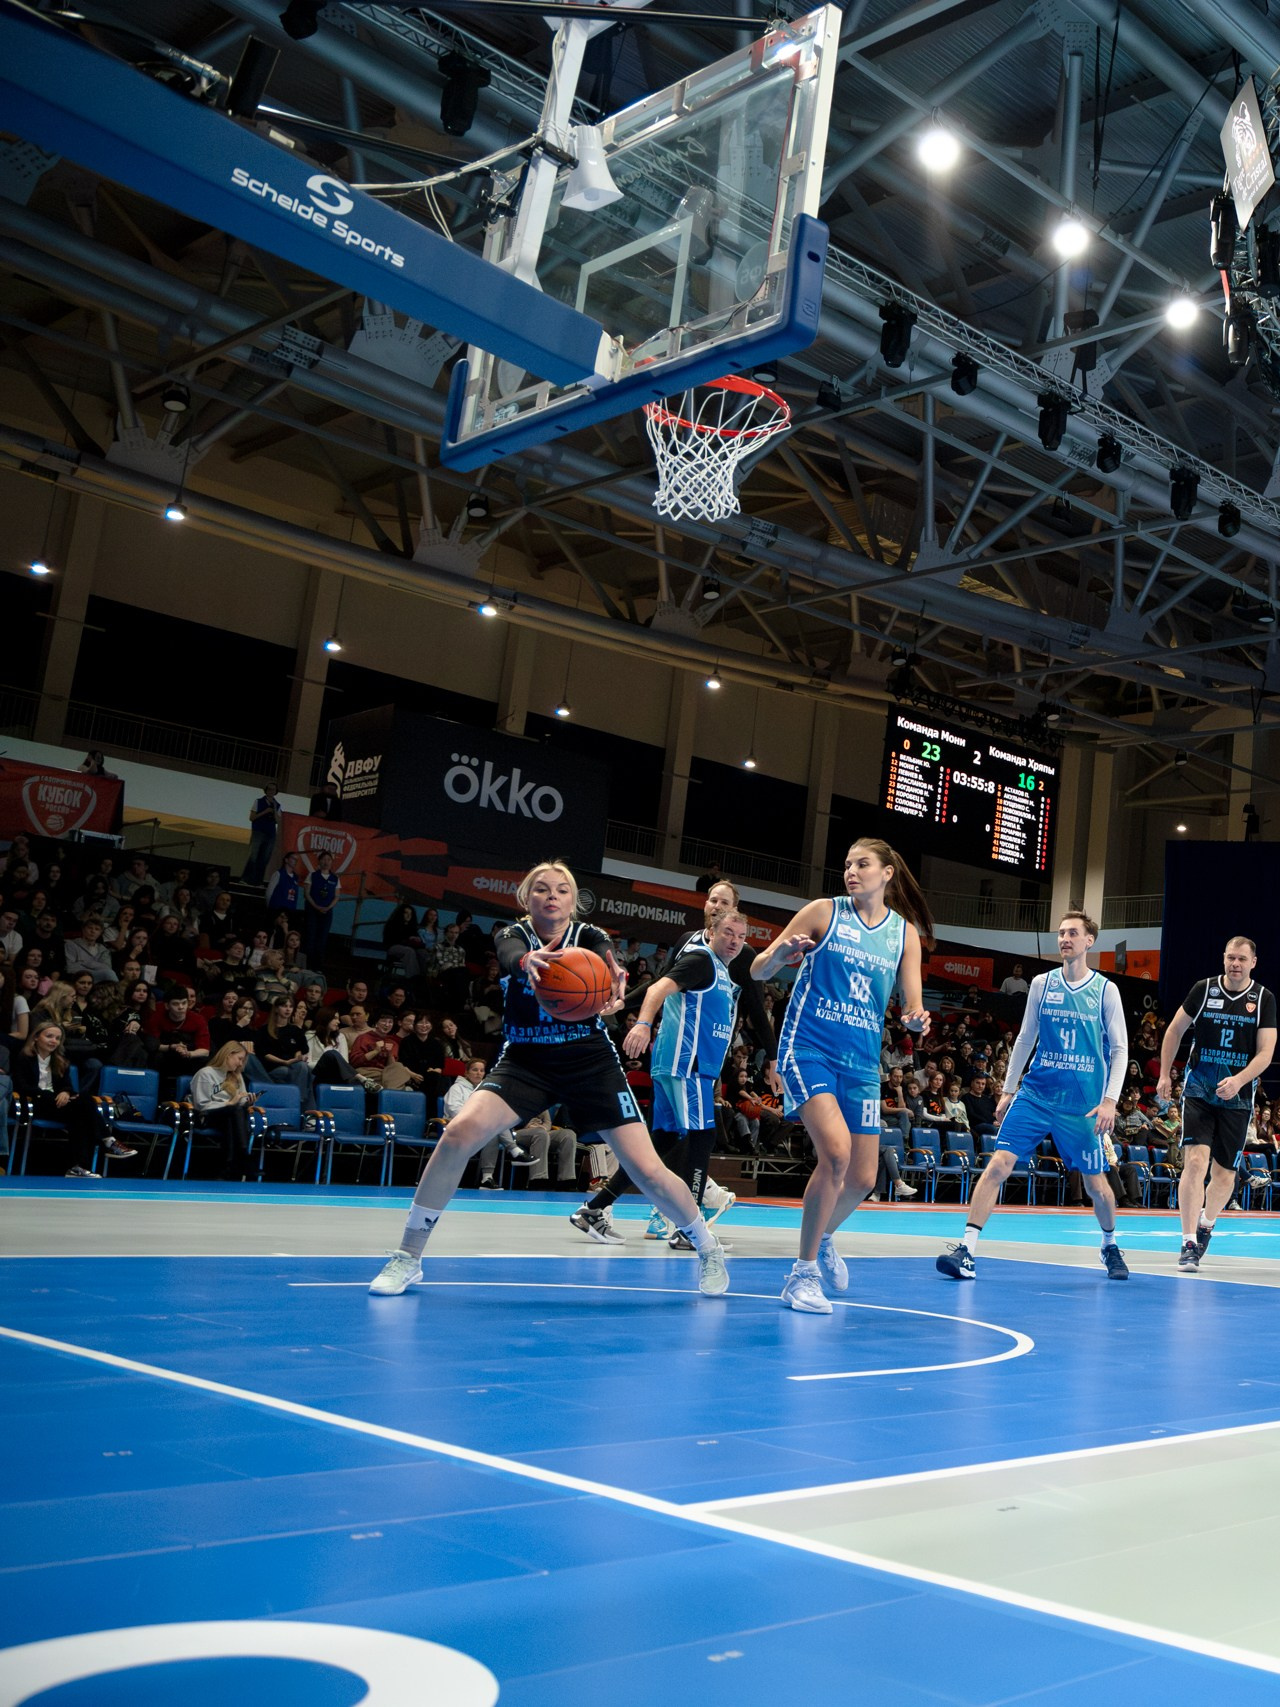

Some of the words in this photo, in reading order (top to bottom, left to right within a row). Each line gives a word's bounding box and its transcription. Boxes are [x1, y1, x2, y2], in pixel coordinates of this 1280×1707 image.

[1246, 151, 1267, 190] Cristal
[231, 168, 328, 228] Schelde
[332, 220, 405, 268] Sports
[898, 716, 939, 738] Команда
[941, 730, 966, 747] Мони
[904, 739, 910, 750] 0
[922, 742, 940, 761] 23
[973, 751, 981, 765] 2
[989, 746, 1026, 766] Команда
[1028, 758, 1055, 775] Хряпы
[345, 755, 382, 779] ДВФУ
[953, 771, 995, 794] 03:55:8
[1018, 773, 1034, 790] 16
[1039, 781, 1044, 791] 2
[38, 784, 82, 808] КУБОК
[952, 815, 958, 823] 0
[985, 824, 990, 832] 0
[310, 833, 345, 854] КУБОК
[473, 877, 518, 895] ФИНА
[600, 898, 686, 926] ГАЗПРОМБАНК
[843, 956, 887, 975] МАТЧ
[944, 961, 980, 978] ФИНАЛ
[815, 1008, 842, 1023] КУБОК
[1214, 1019, 1243, 1027] МАТЧ
[1060, 1027, 1076, 1050] 41
[1220, 1028, 1234, 1048] 12
[1077, 1063, 1094, 1072] 25/26
[1214, 1056, 1233, 1065] РОССИИ
[1082, 1149, 1099, 1170] 41
[693, 1168, 702, 1193] NIKE
